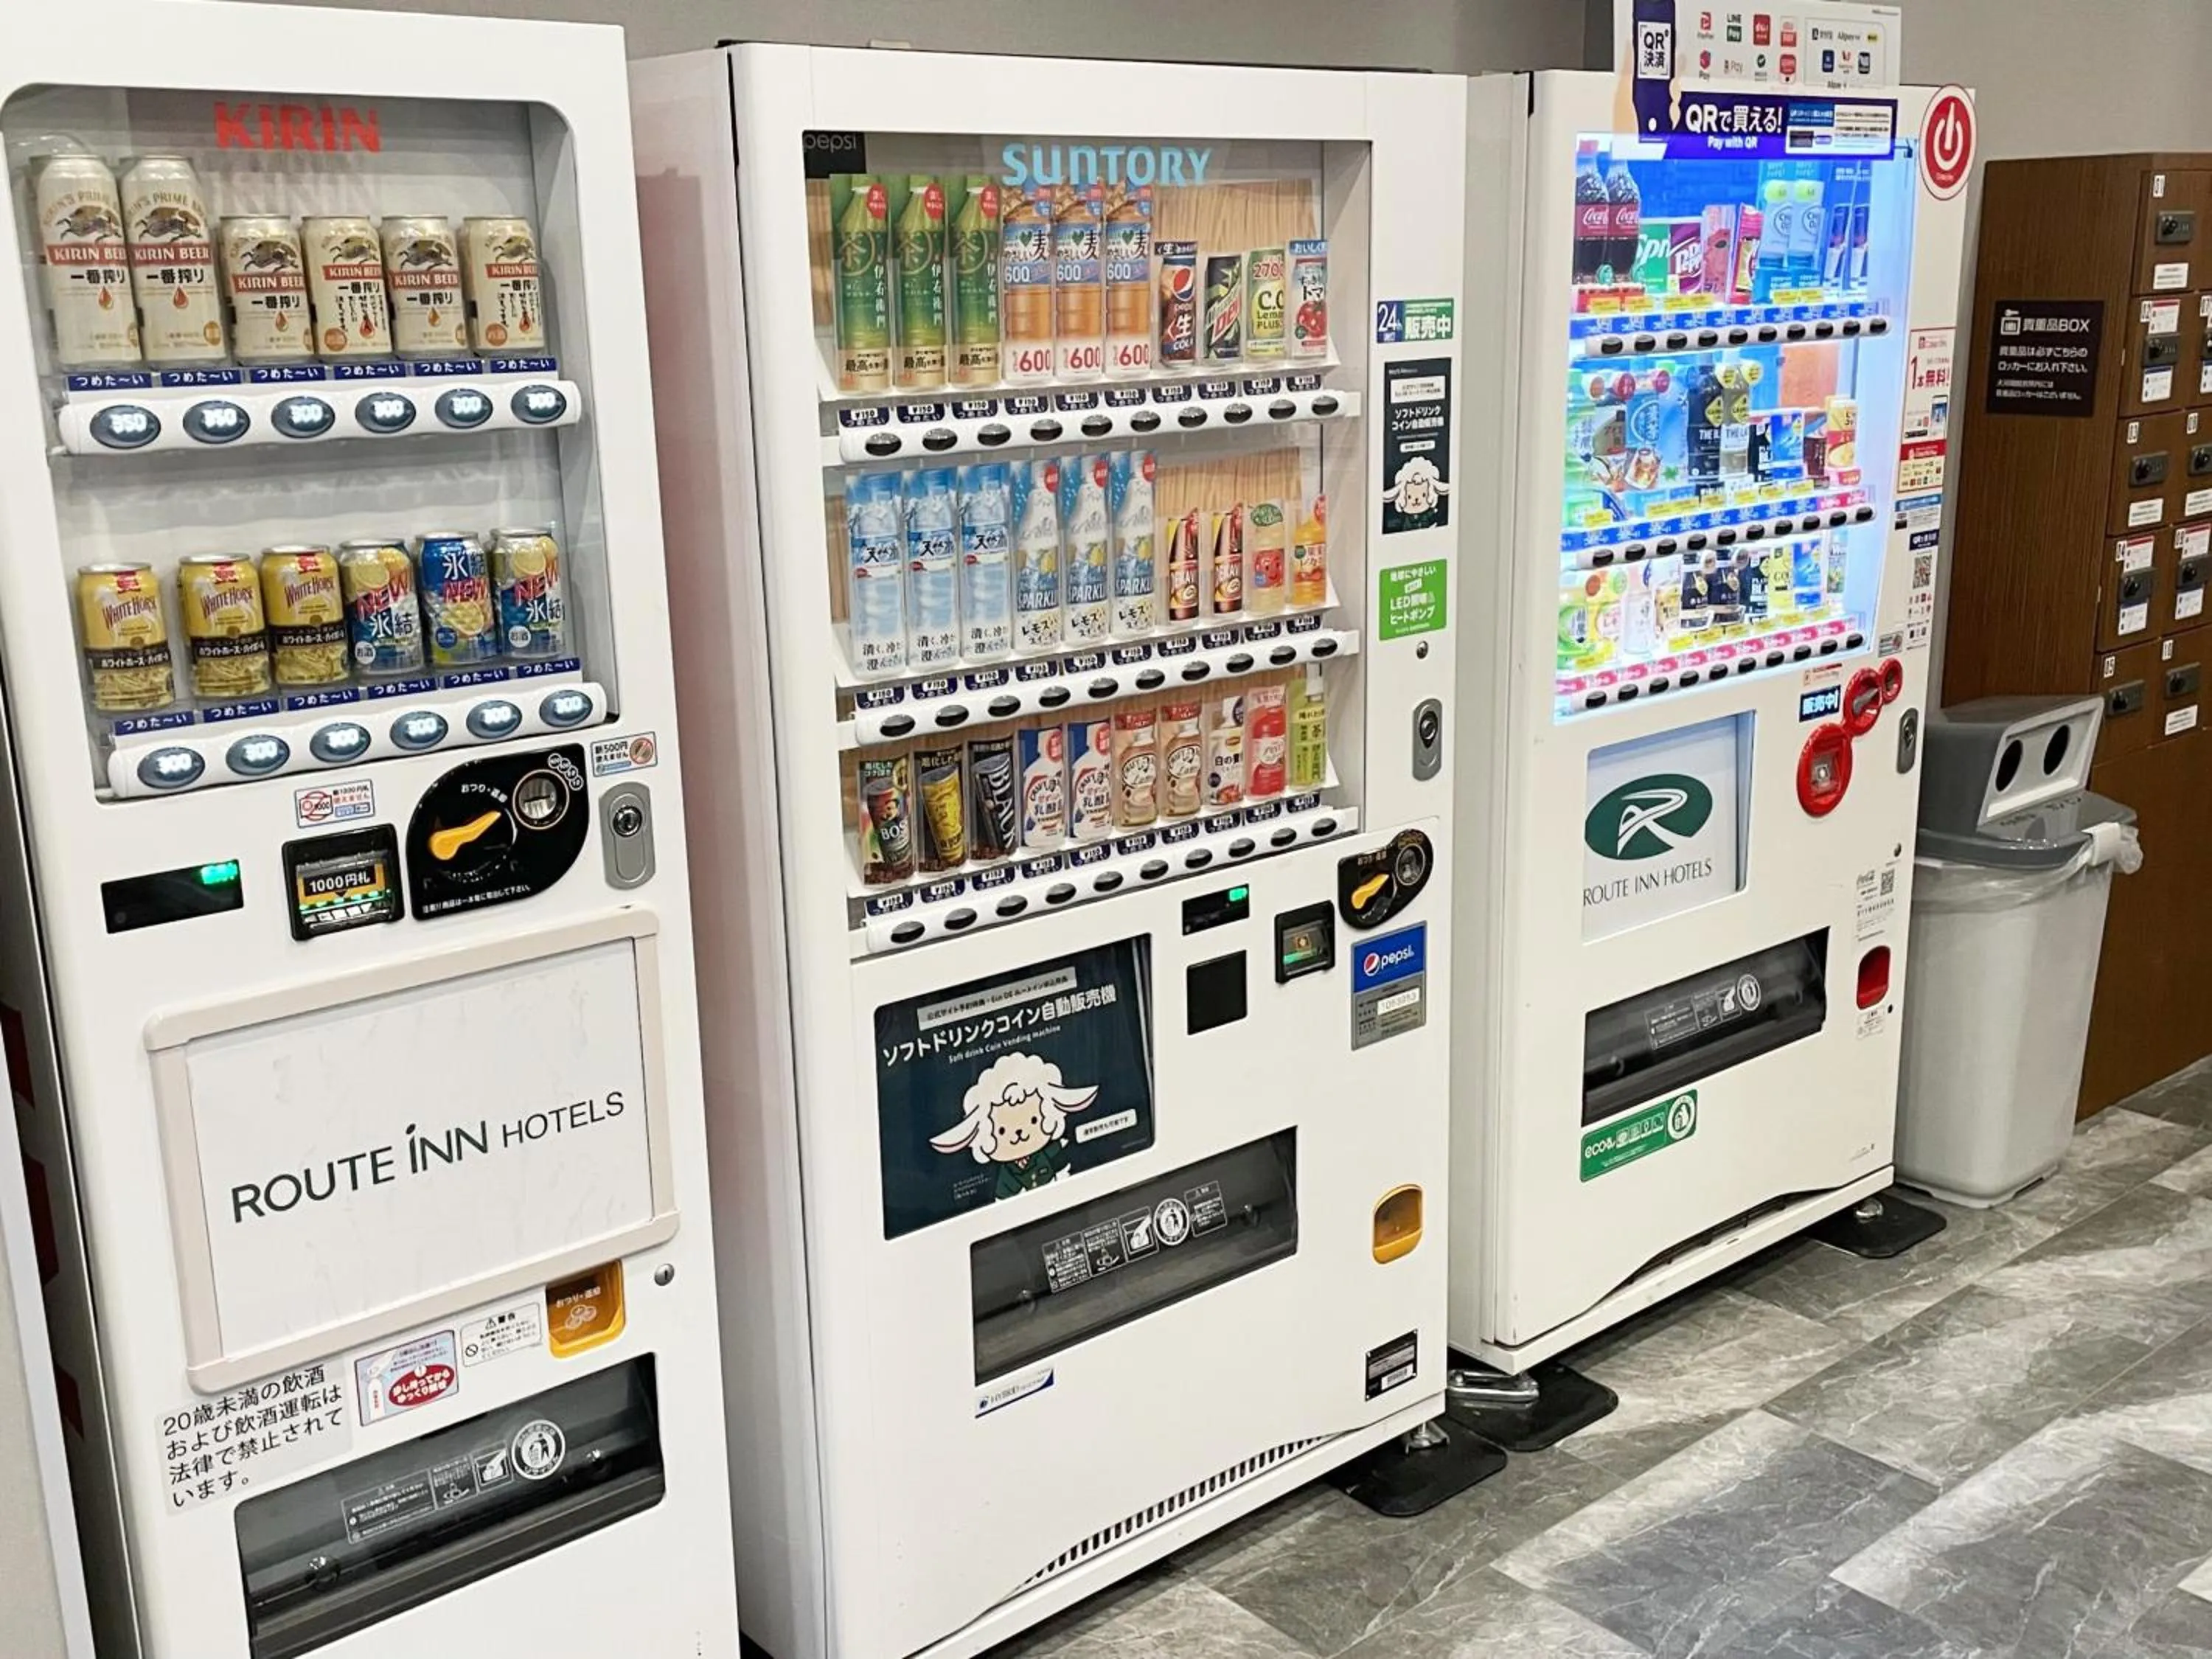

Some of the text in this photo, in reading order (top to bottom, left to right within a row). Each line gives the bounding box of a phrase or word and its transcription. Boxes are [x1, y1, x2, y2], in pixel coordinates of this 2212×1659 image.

[1644, 32, 1664, 49] QR
[1644, 52, 1664, 68] 決済
[215, 100, 381, 152] KIRIN
[1686, 104, 1782, 133] QRで買える!
[804, 133, 857, 153] pepsi
[1708, 136, 1758, 149] Pay with QR
[1002, 144, 1211, 187] SUNTORY
[55, 246, 99, 260] KIRIN
[133, 247, 175, 260] KIRIN
[146, 269, 205, 284] 一番搾り
[238, 276, 276, 288] KIRIN
[330, 265, 361, 276] KIRIN
[395, 274, 431, 286] KIRIN
[1005, 265, 1029, 282] 600
[1057, 264, 1081, 281] 600
[1107, 263, 1130, 279] 600
[1377, 302, 1397, 332] 24
[1405, 316, 1452, 339] 販売中
[356, 577, 412, 616] NEW
[443, 580, 489, 603] NEW
[515, 566, 560, 605] NEW
[369, 611, 413, 638] 氷結
[309, 872, 370, 892] 1000円札
[1583, 858, 1712, 907] ROUTE INN HOTELS
[1381, 945, 1412, 970] pepsi
[883, 984, 1117, 1068] ソフトドリンクコイン自動販売機
[949, 1024, 1062, 1064] Soft drink Coin Vending machine
[231, 1147, 396, 1224] ROUTE
[502, 1091, 626, 1149] HOTELS
[163, 1364, 324, 1436] 20歳未満の飲酒
[167, 1384, 343, 1461] および飲酒運転は
[170, 1407, 344, 1485] 法律で禁止されて
[173, 1470, 250, 1508] います。
